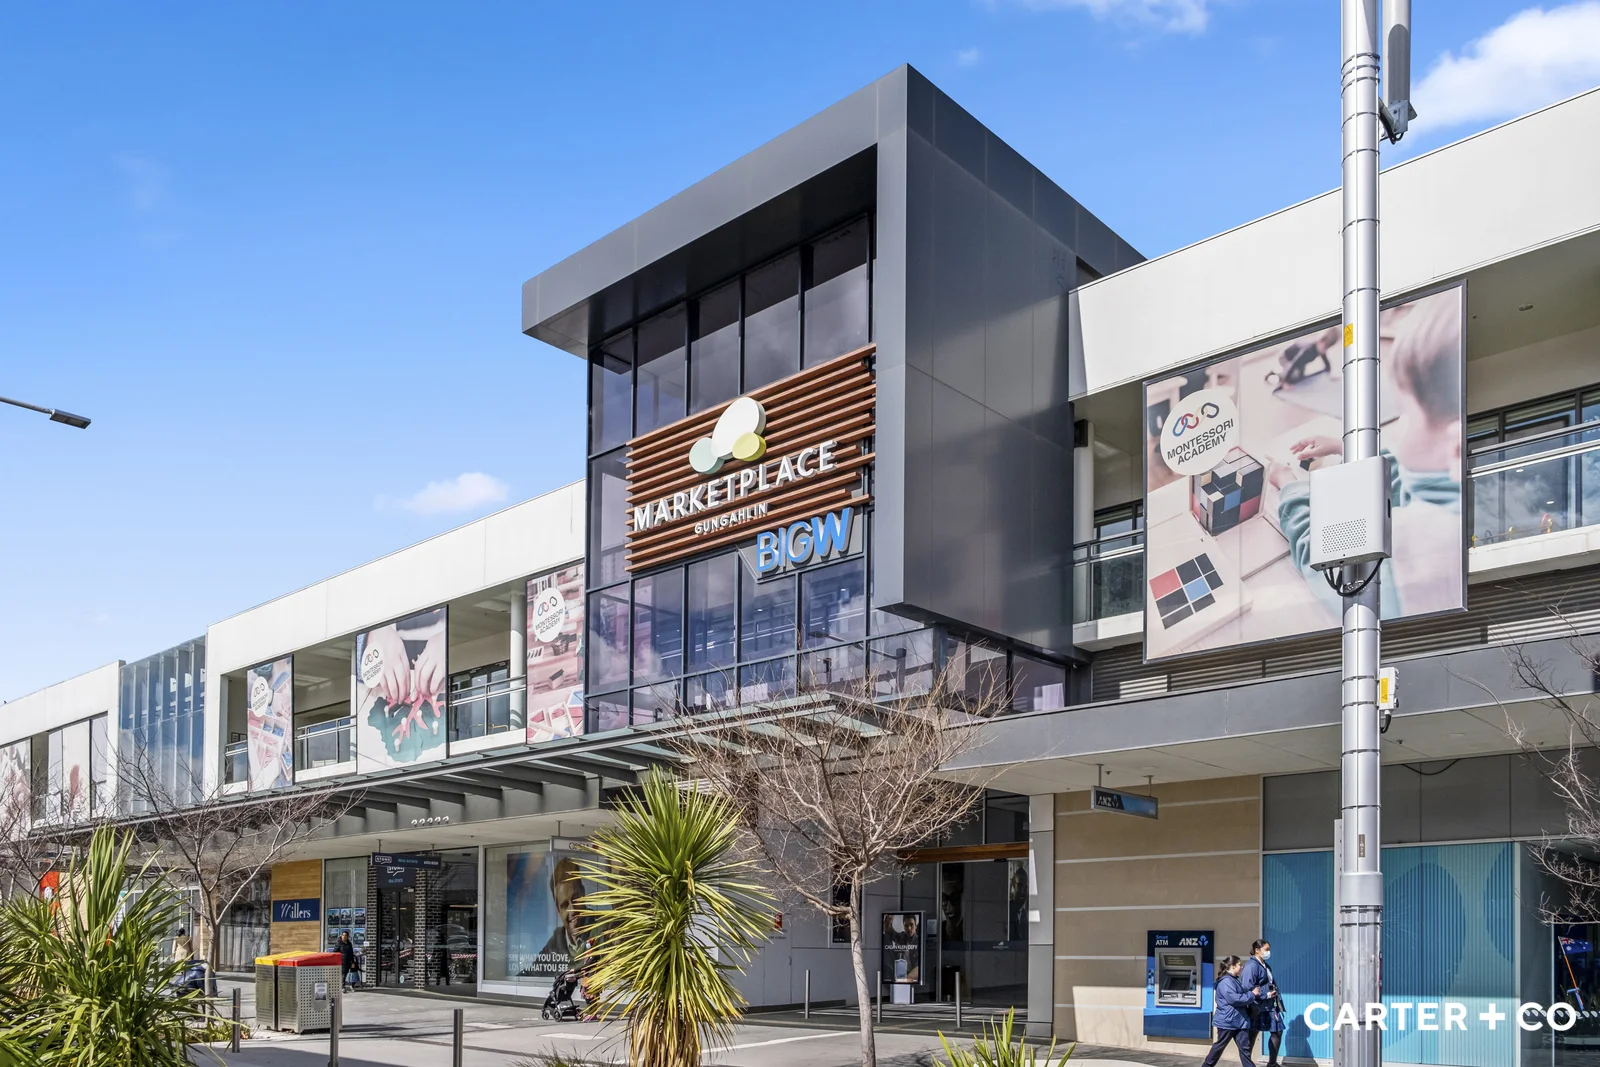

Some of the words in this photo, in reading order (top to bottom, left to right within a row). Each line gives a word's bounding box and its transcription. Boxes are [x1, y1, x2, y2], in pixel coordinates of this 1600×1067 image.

[1167, 418, 1234, 459] MONTESSORI
[1178, 432, 1227, 465] ACADEMY
[633, 440, 838, 533] MARKETPLACE
[694, 502, 769, 535] GUNGAHLIN
[535, 608, 563, 630] MONTESSORI
[540, 617, 560, 634] ACADEMY
[280, 902, 311, 919] Millers
[1178, 937, 1199, 946] ANZ
[508, 953, 519, 962] SEE
[519, 953, 537, 962] WHAT
[538, 953, 552, 962] YOU
[552, 953, 571, 964] LOVE,
[524, 963, 544, 972] WHAT
[543, 963, 557, 972] YOU
